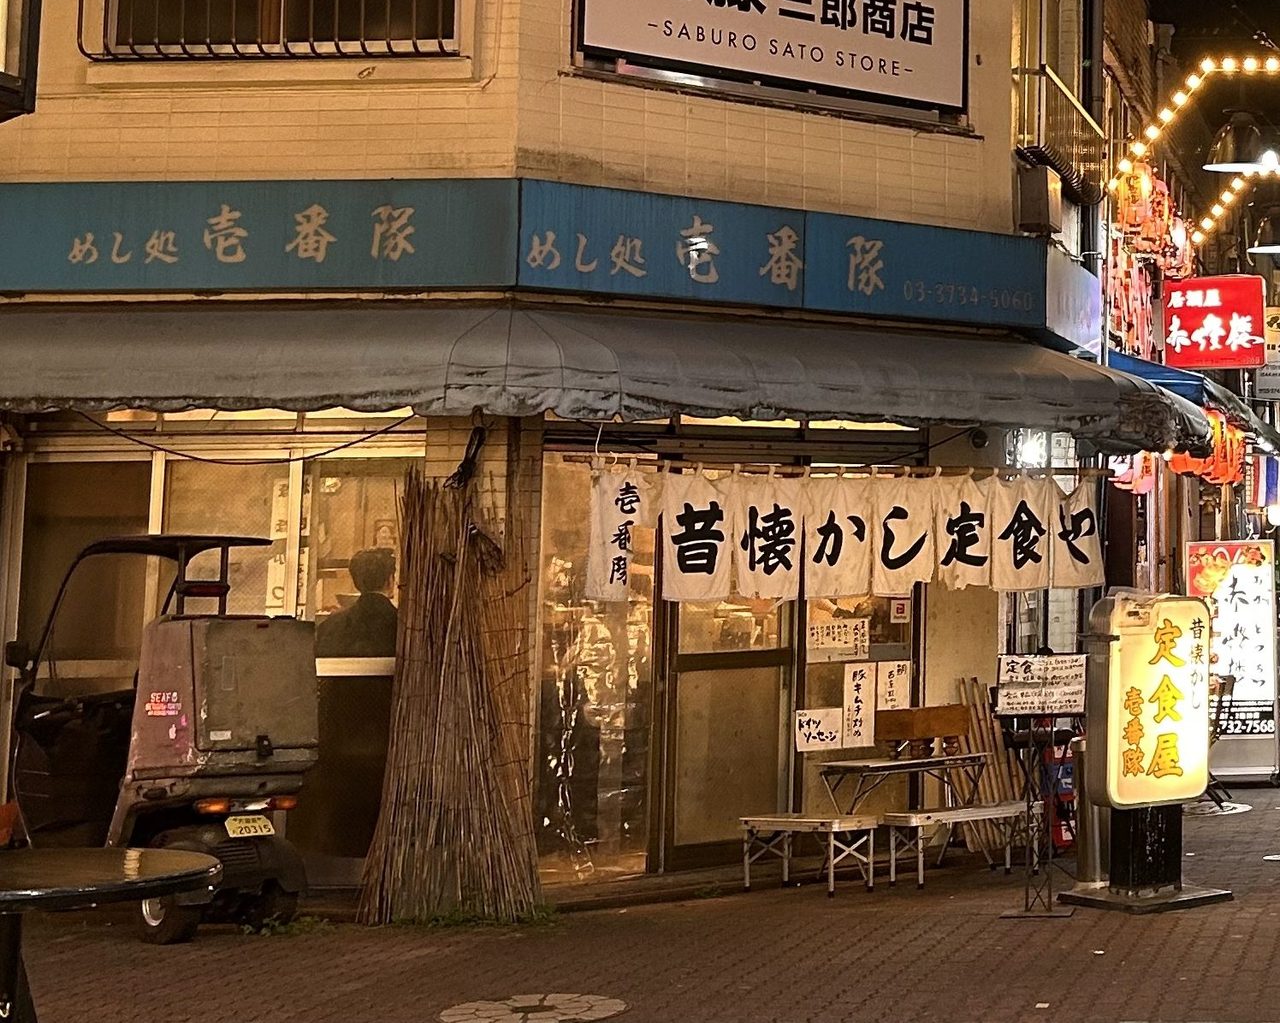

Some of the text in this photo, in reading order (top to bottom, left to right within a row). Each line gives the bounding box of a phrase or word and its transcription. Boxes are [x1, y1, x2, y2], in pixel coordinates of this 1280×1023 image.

[768, 38, 826, 65] SATO
[68, 203, 417, 265] めし処 壱番隊
[525, 230, 648, 279] めし処
[670, 499, 1096, 576] 昔懐かし定食や
[1005, 659, 1034, 675] 定食
[1146, 618, 1185, 778] 定食屋
[852, 669, 867, 738] 豚キムチ炒め
[1122, 685, 1145, 777] 壱番隊
